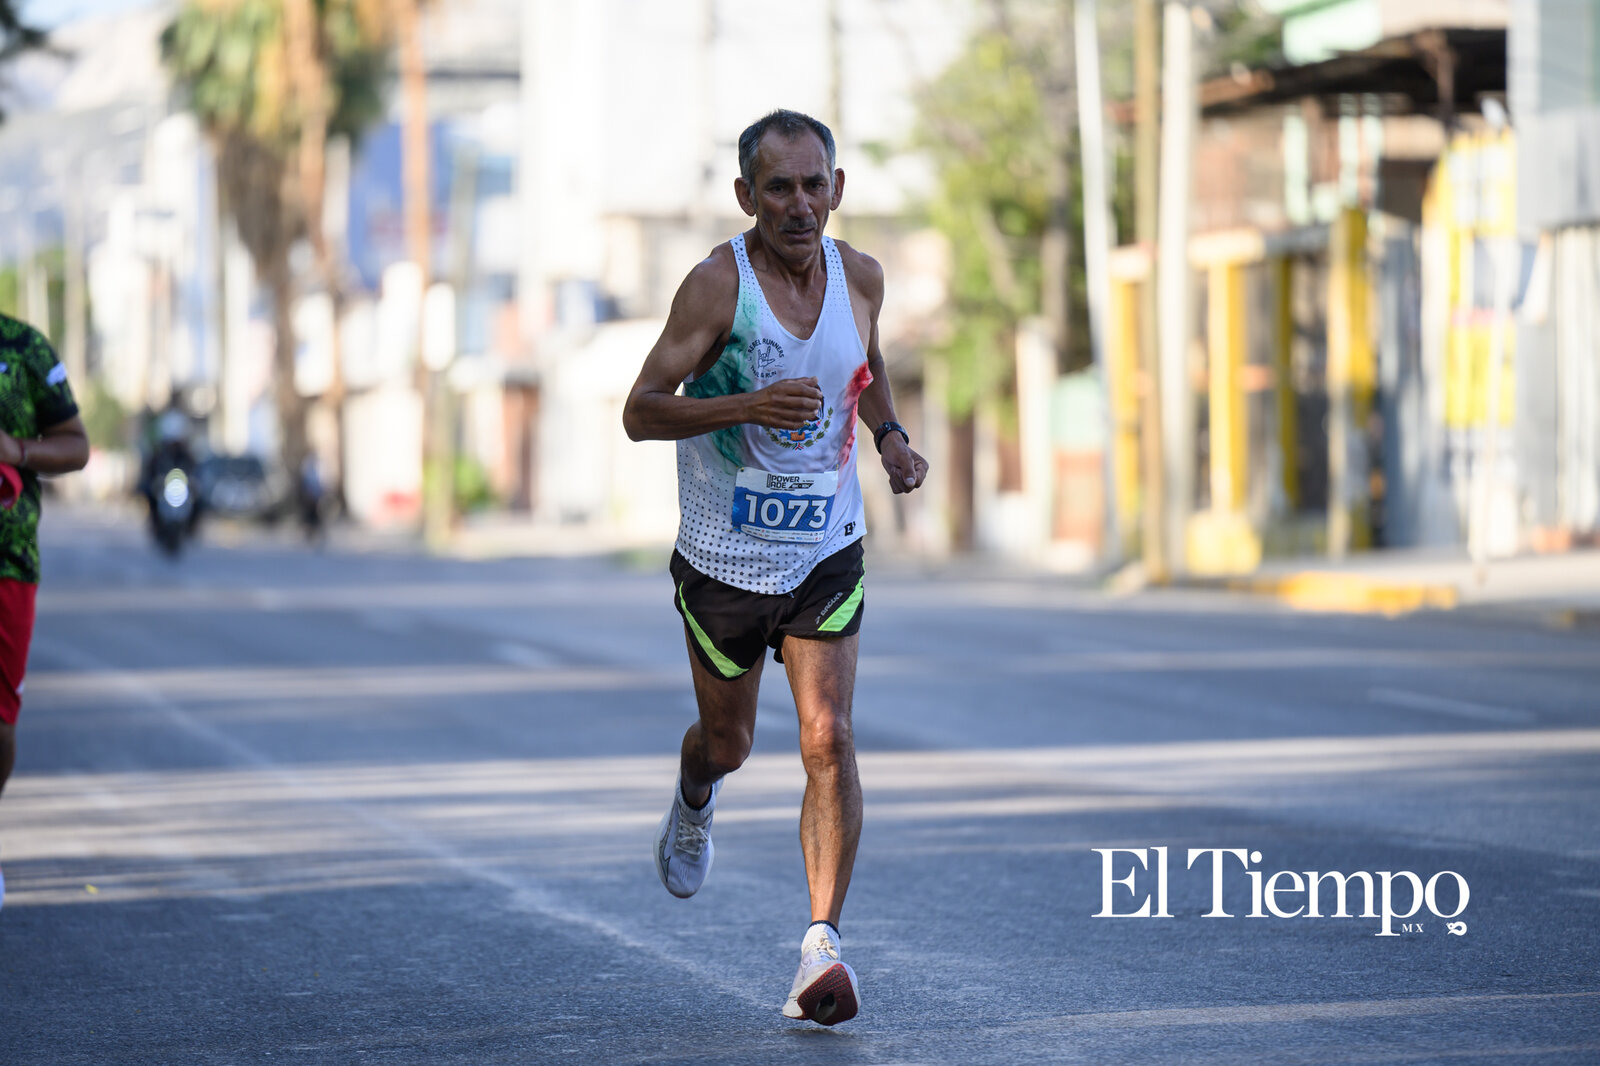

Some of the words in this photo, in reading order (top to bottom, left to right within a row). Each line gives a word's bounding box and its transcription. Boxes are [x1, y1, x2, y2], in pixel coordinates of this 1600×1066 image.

[747, 339, 762, 353] REBEL
[762, 338, 785, 358] RUNNERS
[745, 494, 828, 529] 1073
